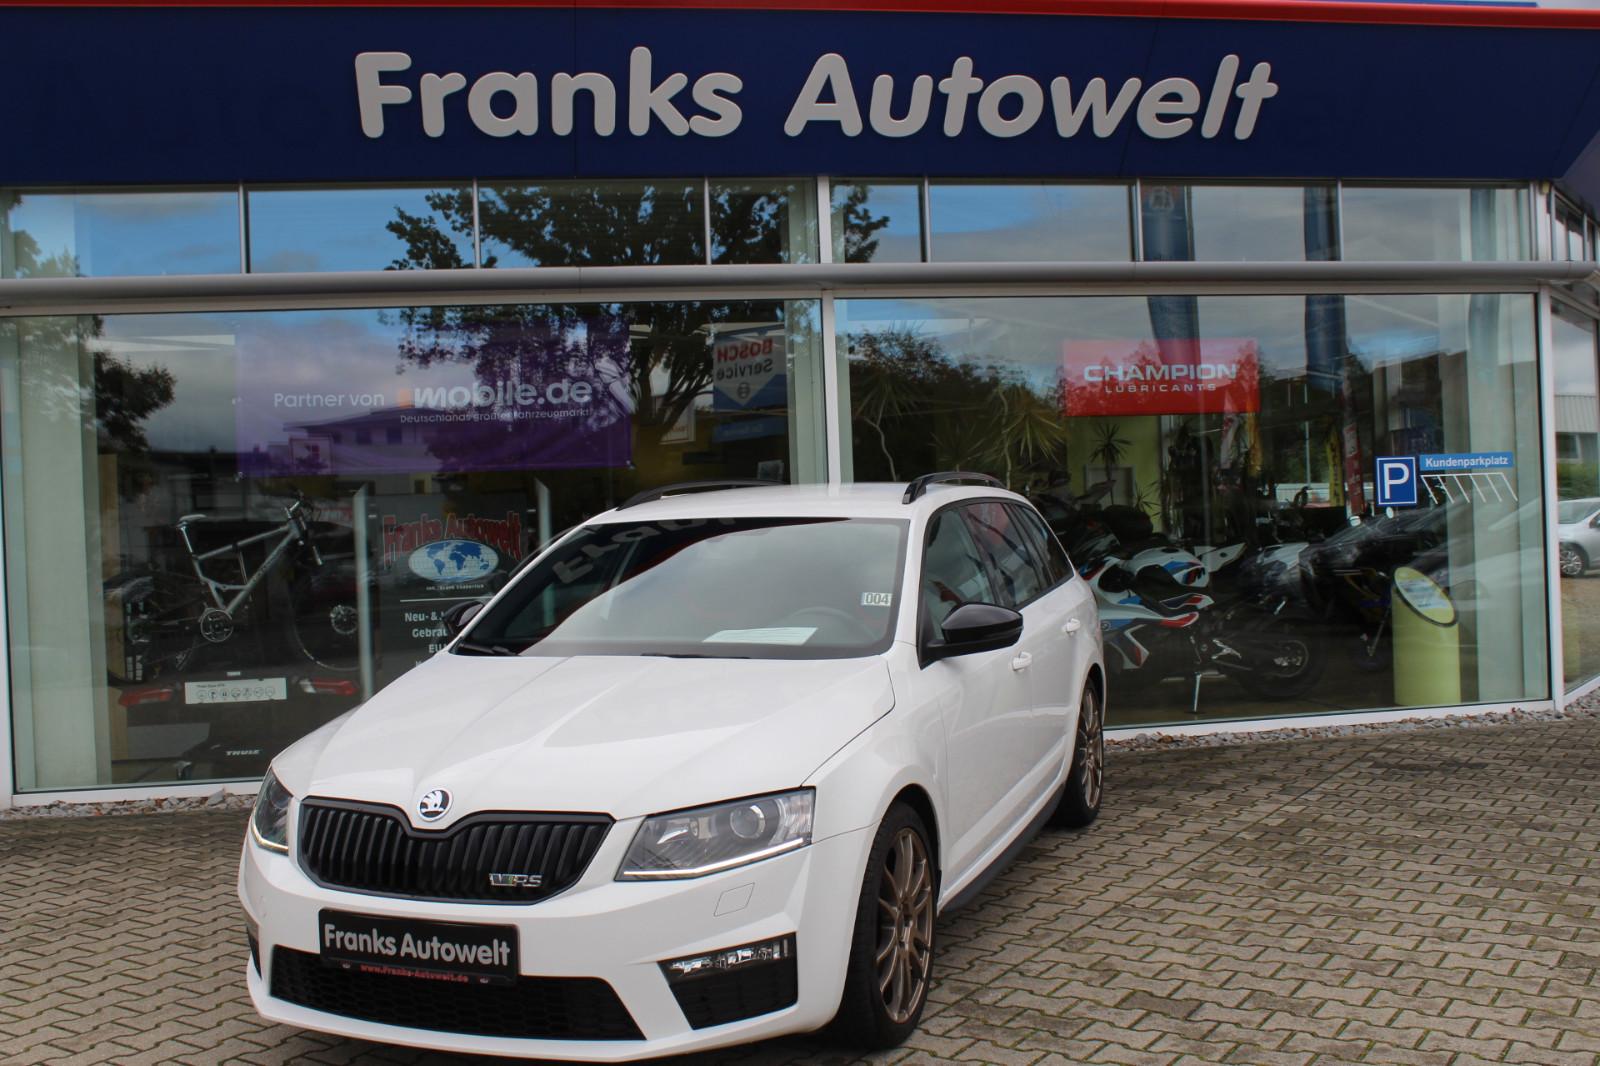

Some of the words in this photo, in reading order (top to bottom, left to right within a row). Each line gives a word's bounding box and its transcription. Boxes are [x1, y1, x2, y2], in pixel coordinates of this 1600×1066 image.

[354, 45, 744, 138] Franks
[784, 52, 1278, 141] Autowelt
[1083, 363, 1237, 382] CHAMPION
[273, 391, 345, 407] Partner
[349, 392, 385, 406] von
[413, 378, 592, 407] mobile.de
[1104, 383, 1216, 394] LUBRICANTS
[1383, 462, 1410, 500] P
[1425, 455, 1509, 468] Kundenparkplatz
[865, 592, 889, 605] 004
[324, 923, 397, 956] Franks
[400, 932, 511, 966] Autowelt
